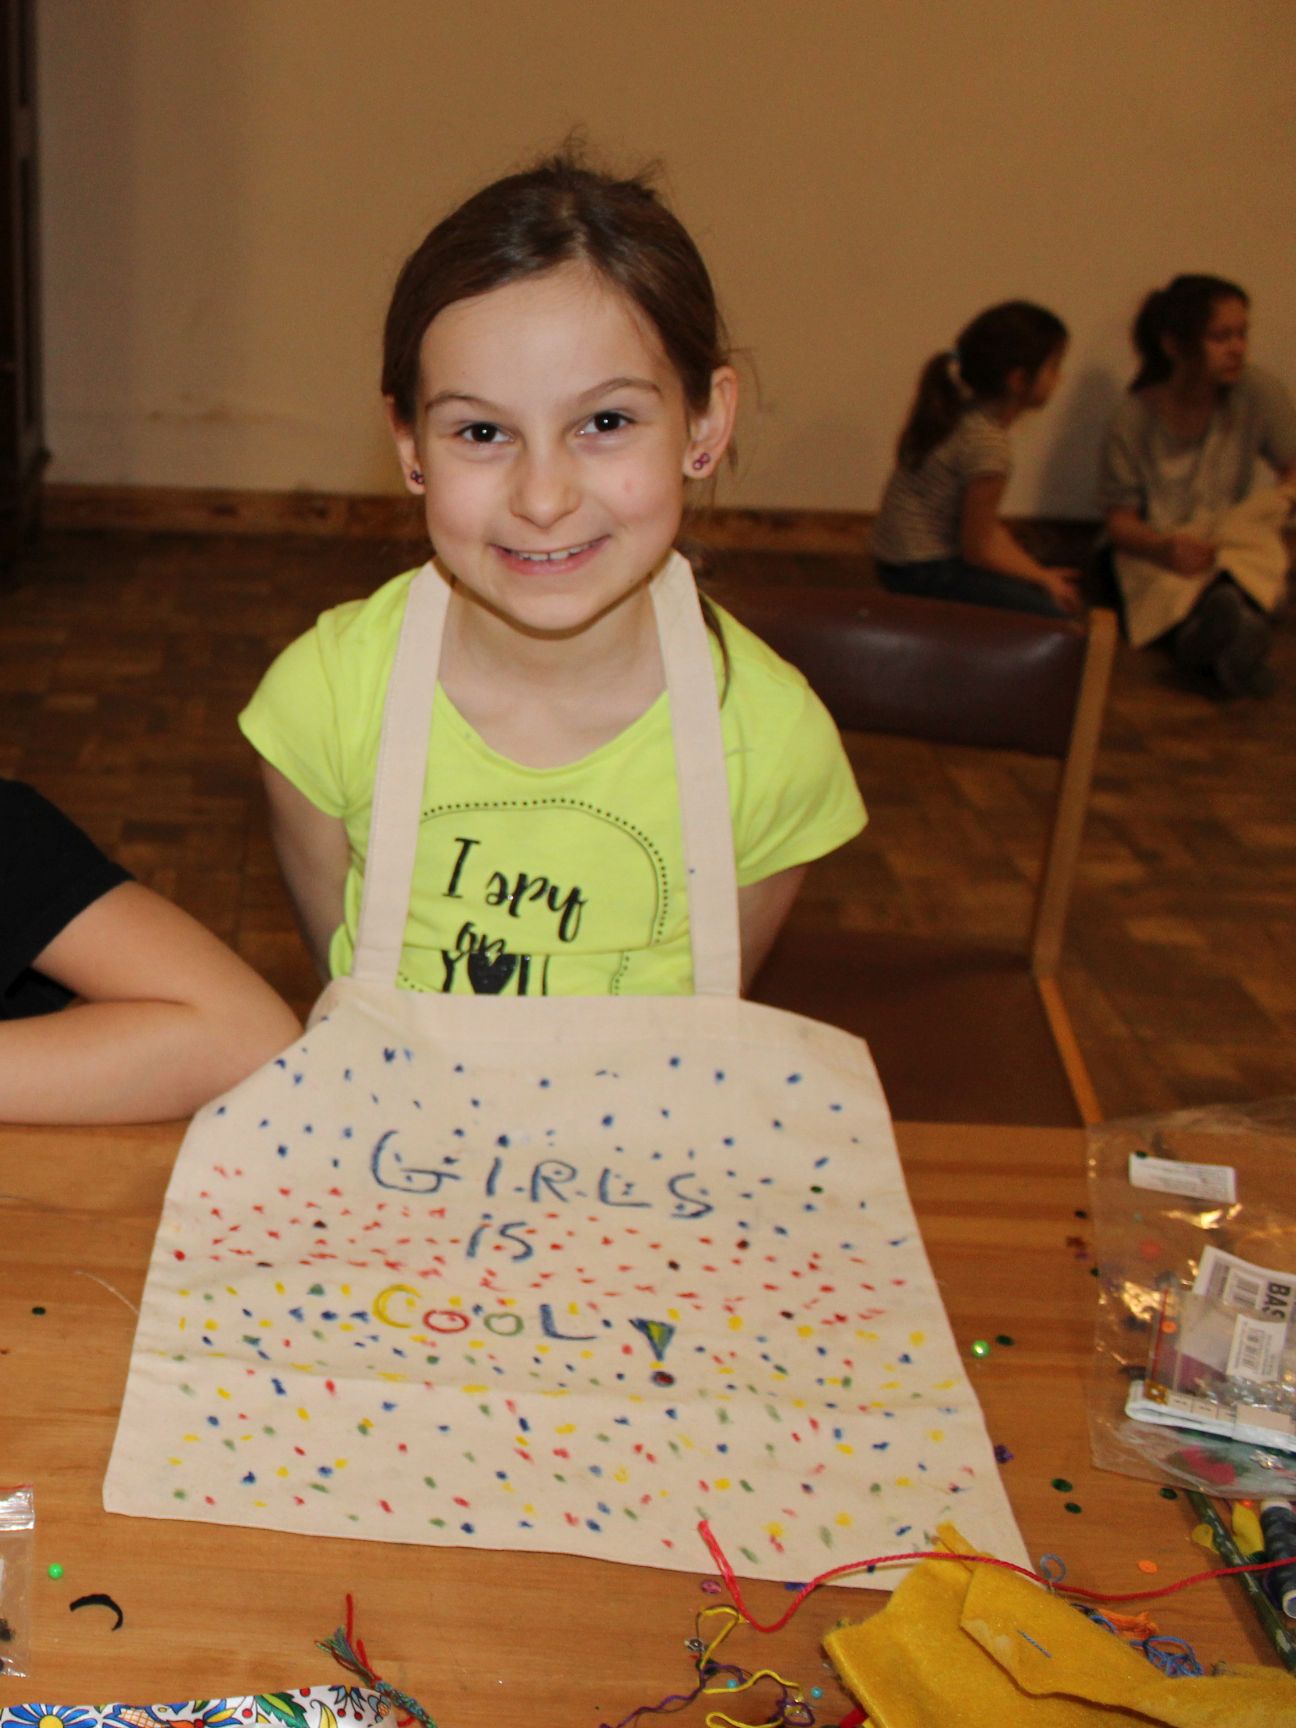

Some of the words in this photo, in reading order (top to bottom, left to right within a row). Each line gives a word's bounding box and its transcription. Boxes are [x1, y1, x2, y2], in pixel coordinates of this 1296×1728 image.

[442, 836, 482, 899] I
[485, 871, 589, 943] spy
[371, 1130, 715, 1220] GIRLS
